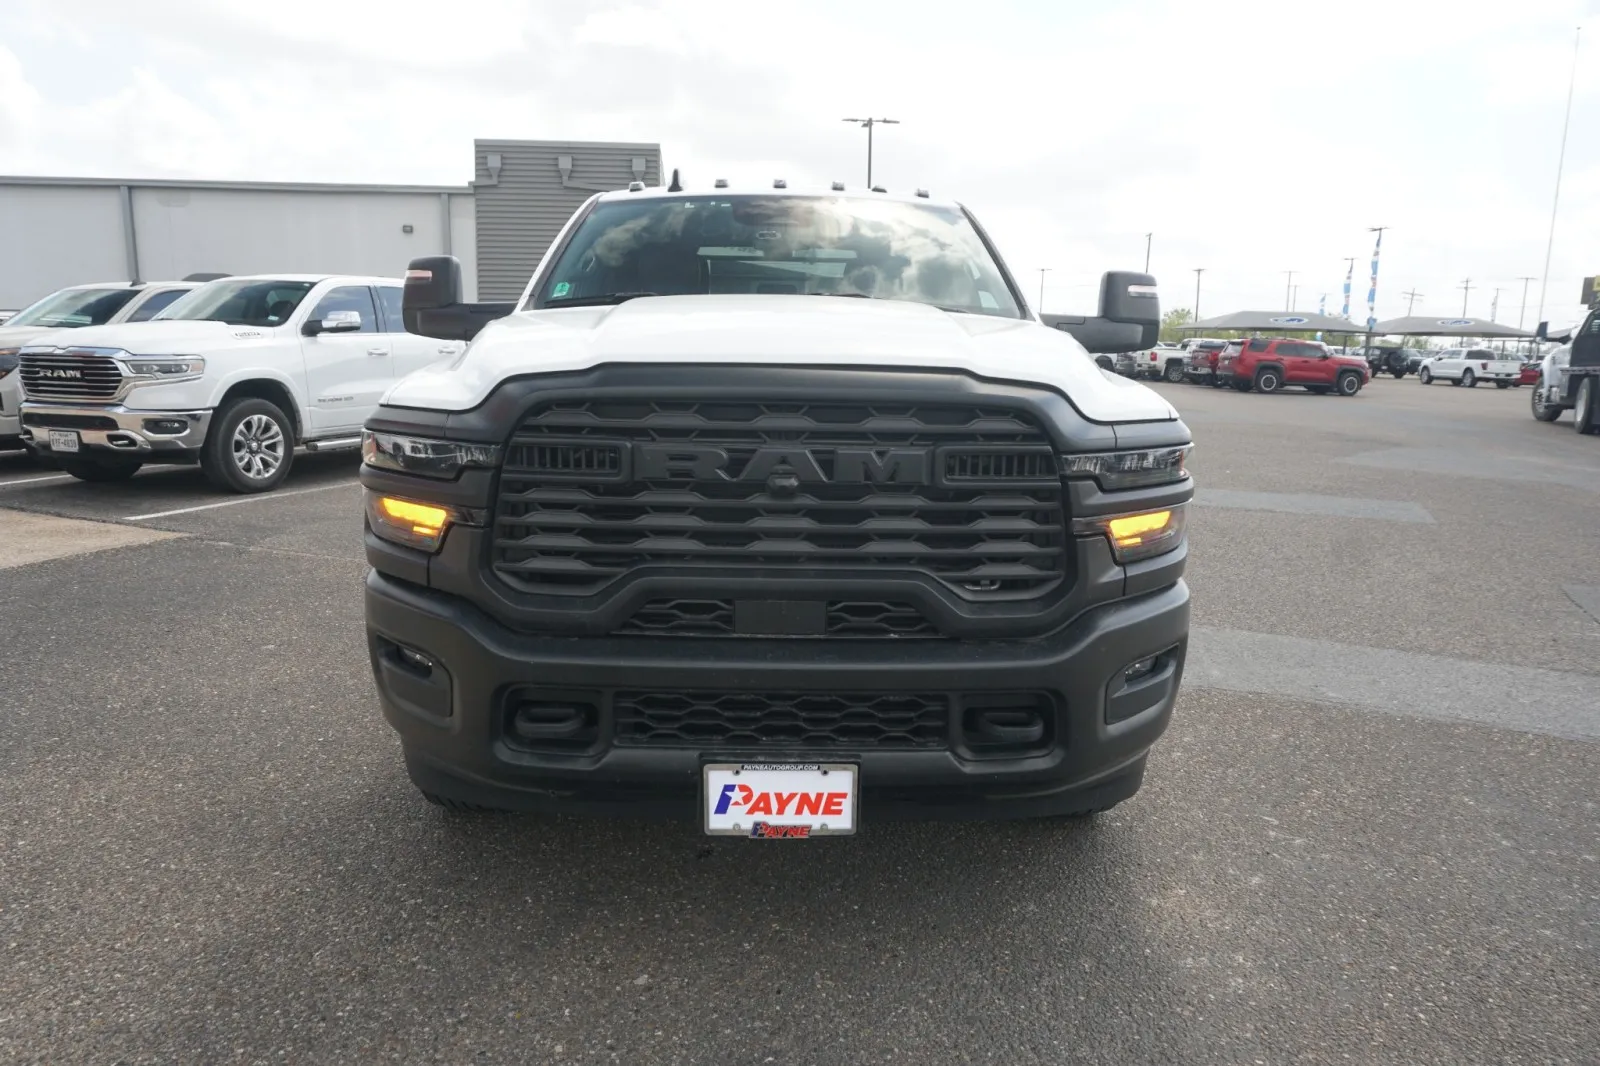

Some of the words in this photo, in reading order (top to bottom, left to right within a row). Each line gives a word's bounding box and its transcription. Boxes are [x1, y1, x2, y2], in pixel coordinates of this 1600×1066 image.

[39, 369, 81, 378] RAM
[638, 446, 929, 484] RAM
[714, 784, 848, 815] PAYNE
[751, 821, 811, 837] PAYNE
